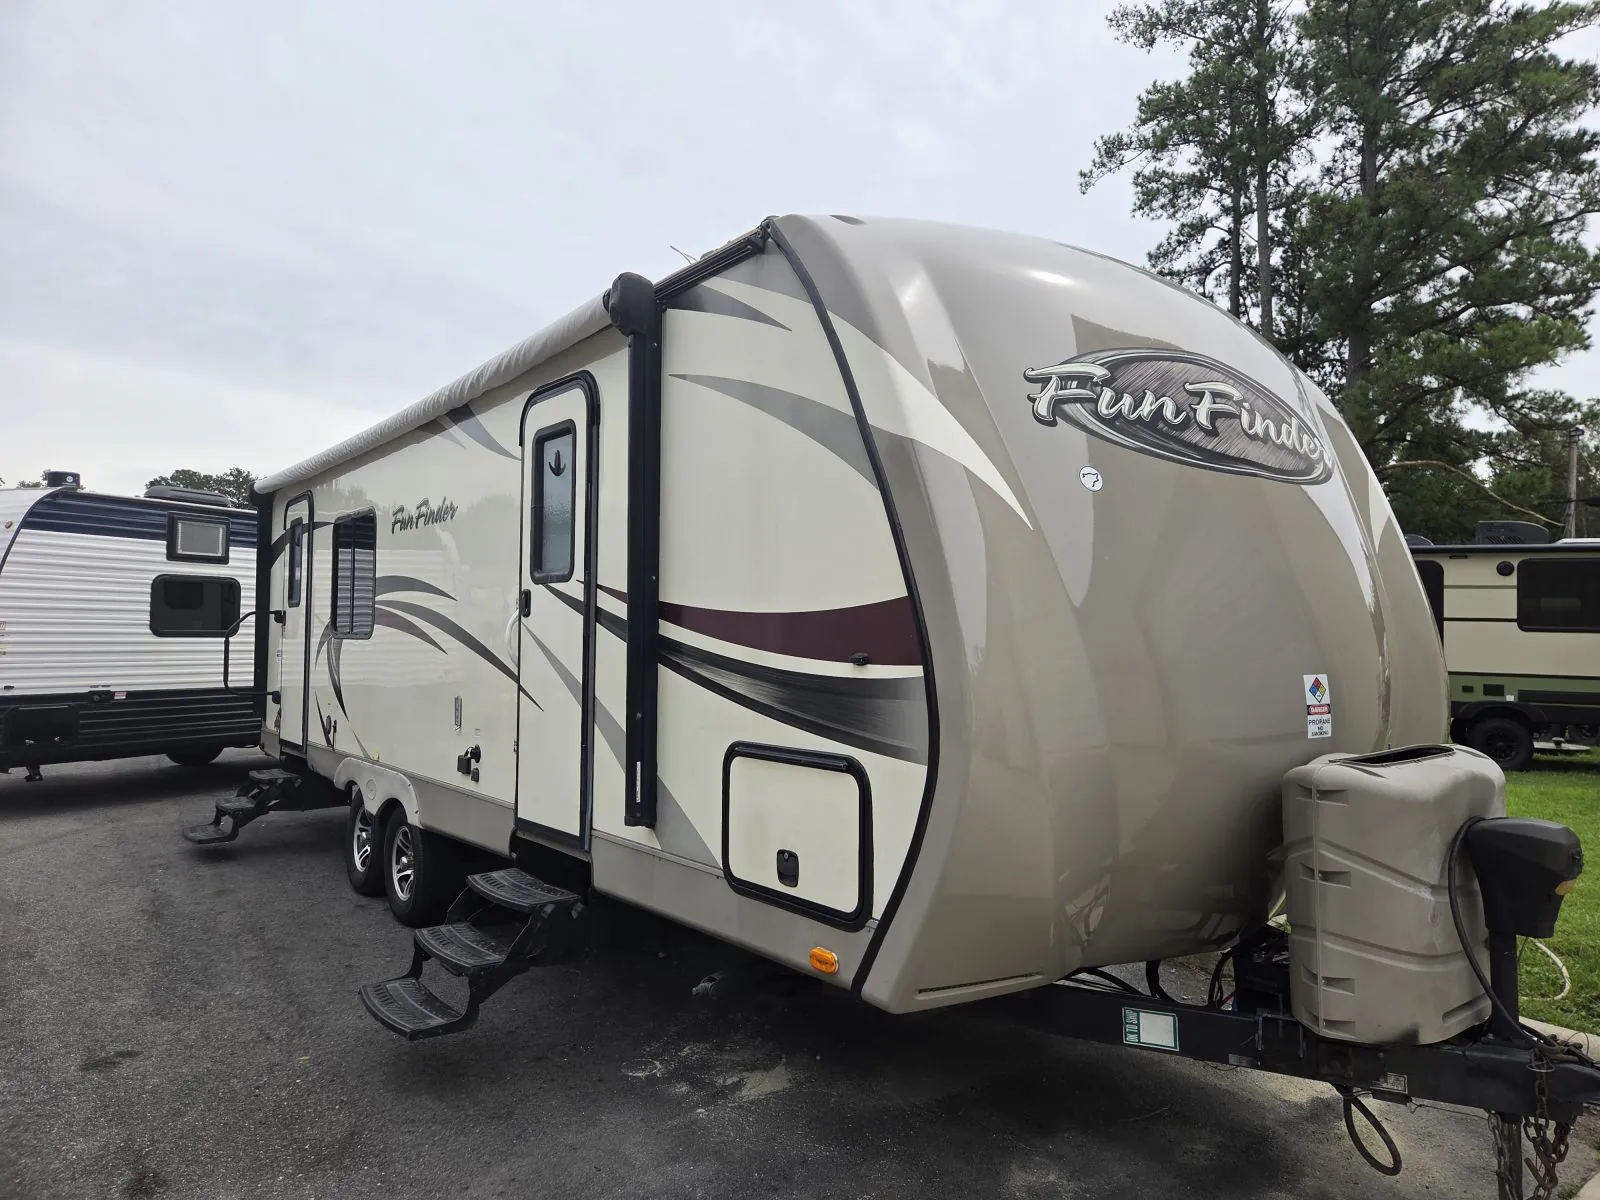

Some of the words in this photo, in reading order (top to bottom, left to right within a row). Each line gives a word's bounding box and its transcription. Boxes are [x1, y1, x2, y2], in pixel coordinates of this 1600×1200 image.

[1023, 361, 1188, 425] Fun
[391, 504, 415, 535] Fun
[416, 496, 459, 529] Finder
[1308, 718, 1330, 726] PROPANE
[1125, 1024, 1138, 1032] TO
